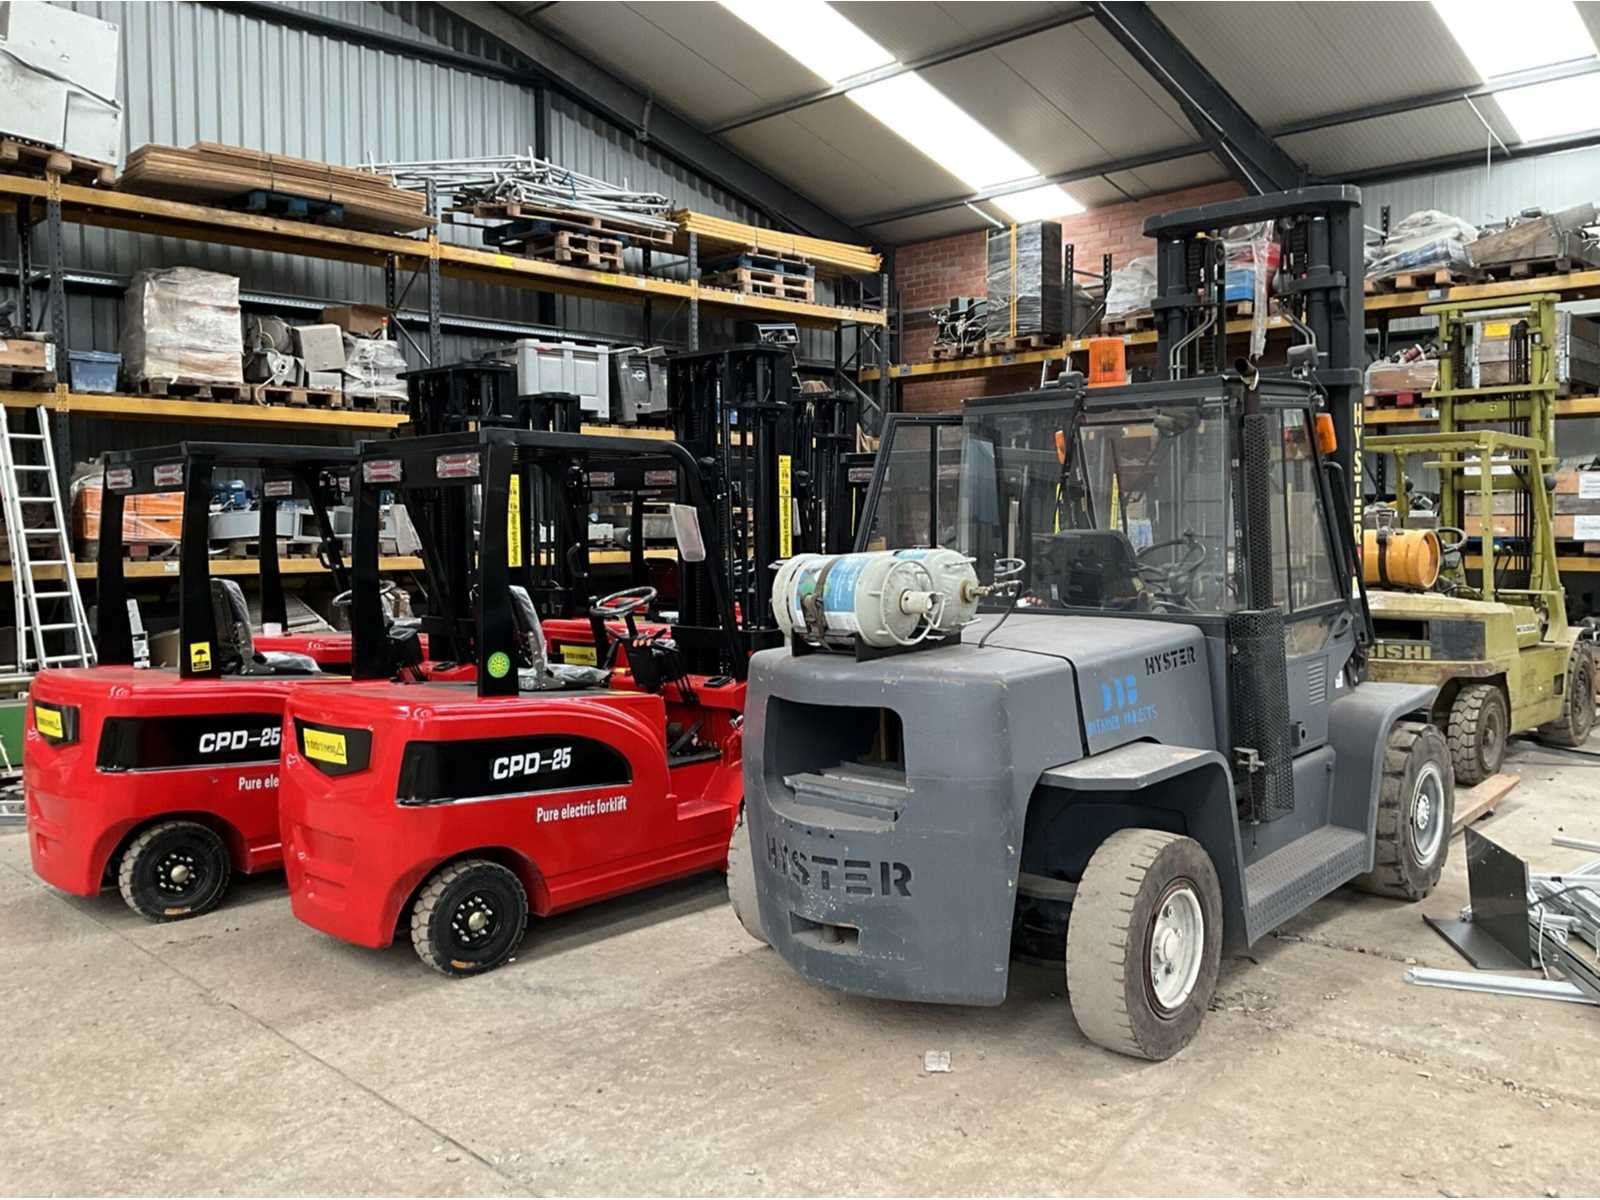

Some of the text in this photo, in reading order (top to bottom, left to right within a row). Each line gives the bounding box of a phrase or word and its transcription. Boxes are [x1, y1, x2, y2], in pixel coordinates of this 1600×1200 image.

[1353, 402, 1363, 546] HYSTER
[1144, 645, 1196, 676] HYSTER
[198, 726, 282, 753] CPD-25
[492, 746, 573, 780] CPD-25
[238, 776, 262, 791] Pure
[536, 794, 628, 823] Pure electric forklift
[766, 832, 912, 897] HYSTER
